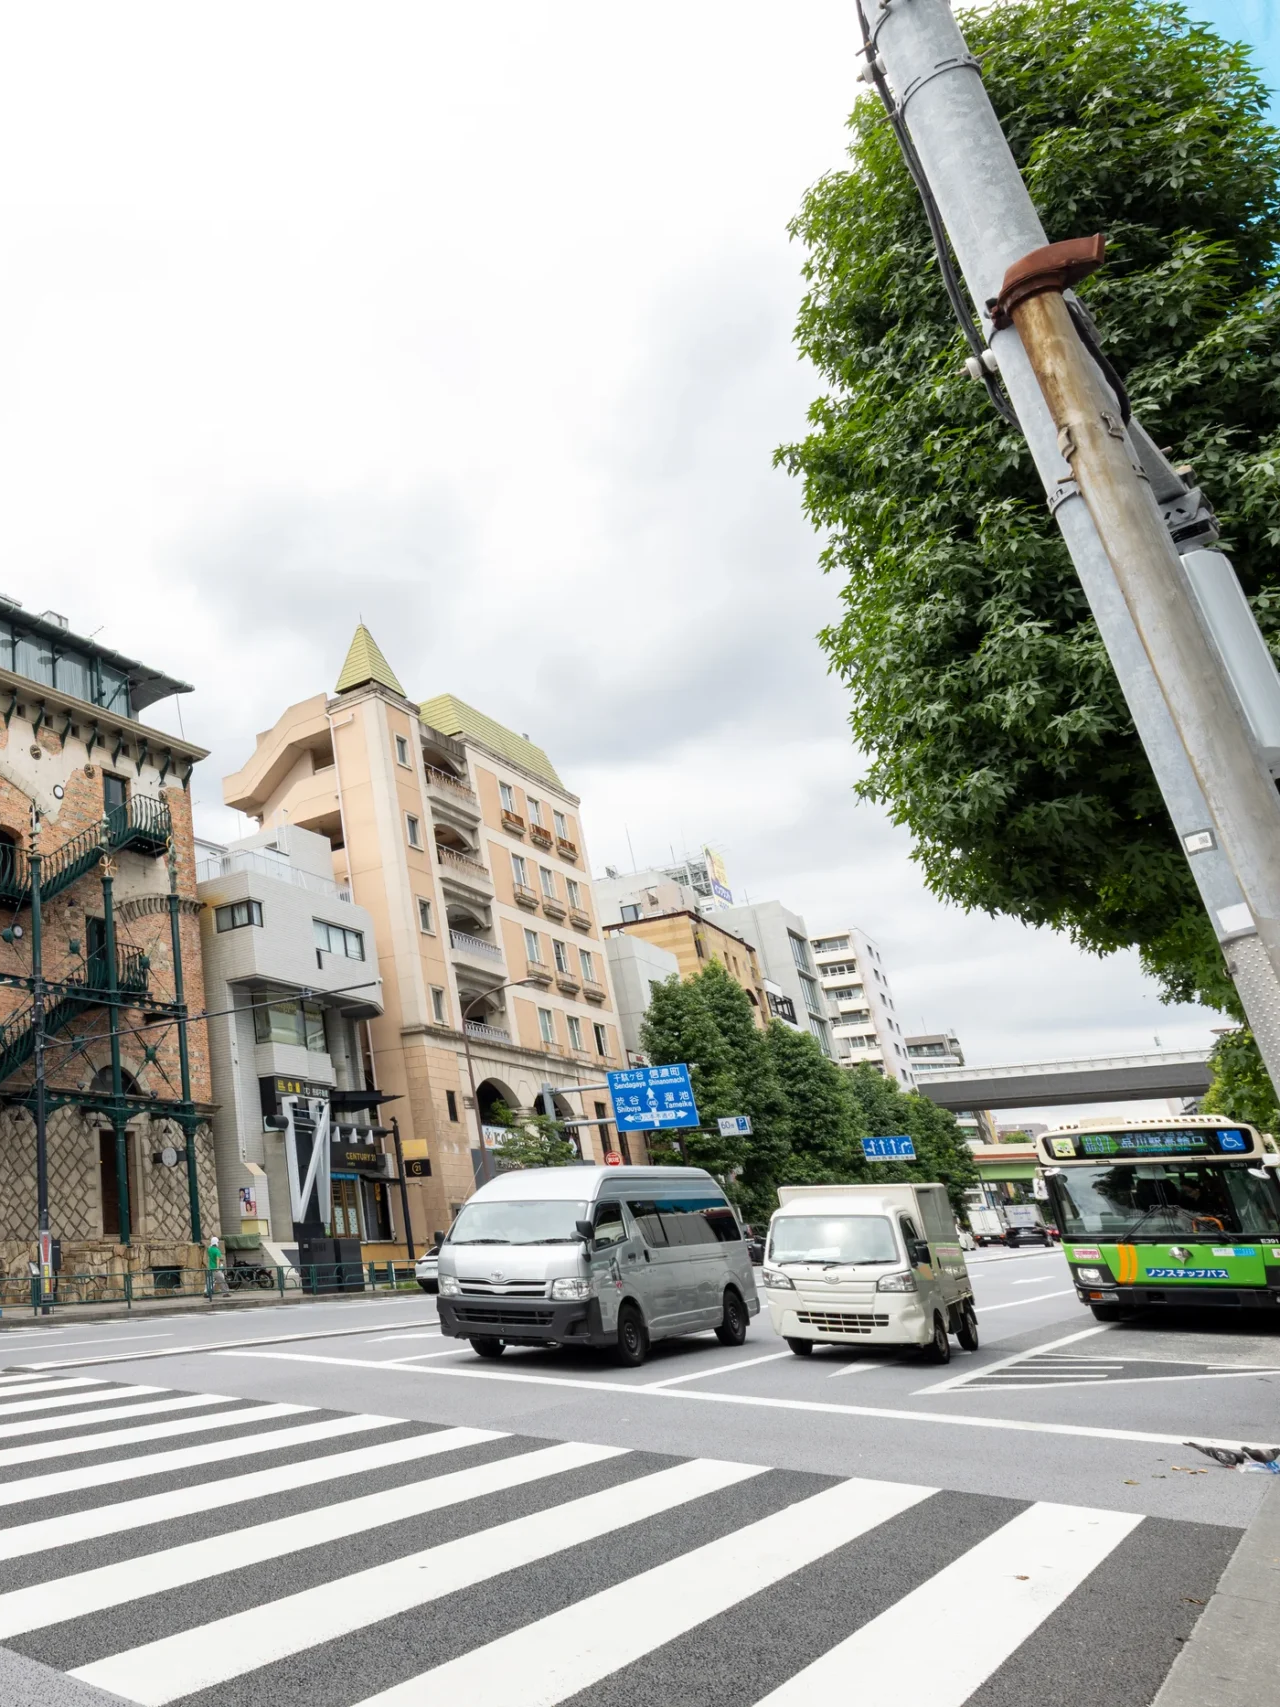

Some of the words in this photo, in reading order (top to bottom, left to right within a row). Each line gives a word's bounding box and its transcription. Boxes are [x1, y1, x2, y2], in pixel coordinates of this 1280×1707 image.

[649, 1067, 679, 1078] 信濃町
[614, 1081, 646, 1090] Sendagaya
[648, 1076, 685, 1086] Shinanomachi
[617, 1105, 641, 1113] Shibuya
[664, 1100, 692, 1109] Tameike
[345, 1152, 370, 1161] CENTURY
[1148, 1268, 1229, 1278] ノンステップバス
